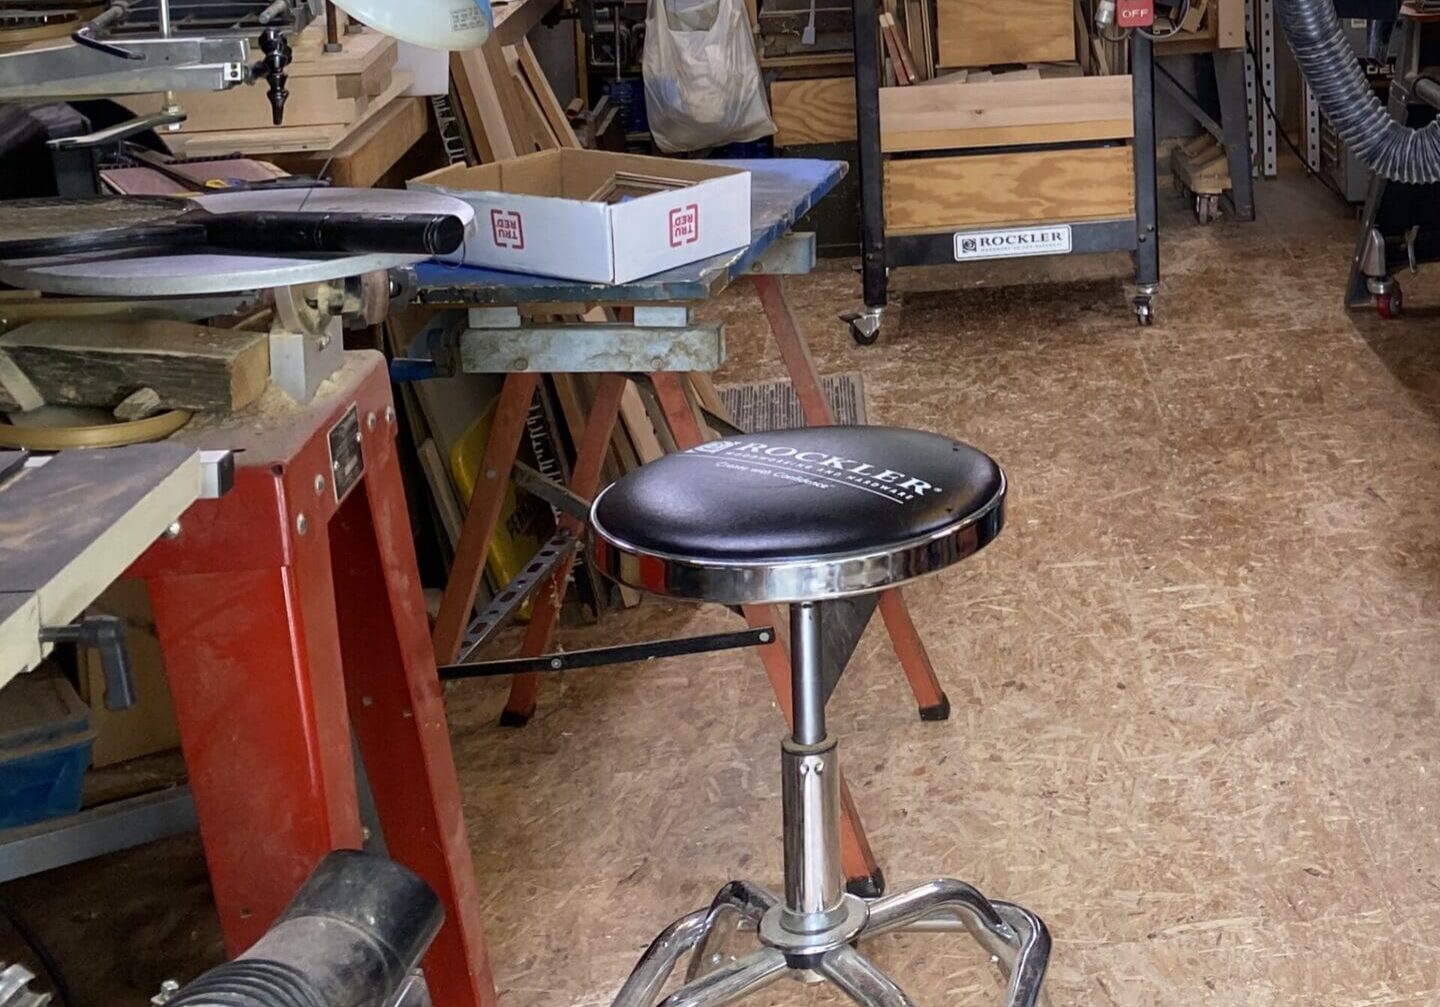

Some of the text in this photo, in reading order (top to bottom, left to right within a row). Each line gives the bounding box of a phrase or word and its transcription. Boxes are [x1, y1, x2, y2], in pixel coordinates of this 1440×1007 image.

[1121, 8, 1149, 19] OFF
[496, 218, 517, 230] RED
[674, 213, 694, 226] RED
[498, 228, 518, 240] TRU
[675, 224, 693, 238] TRU
[980, 231, 1063, 247] ROCKLER
[736, 441, 933, 496] ROCKLER
[815, 466, 842, 478] AND
[847, 474, 915, 501] HARDWARE
